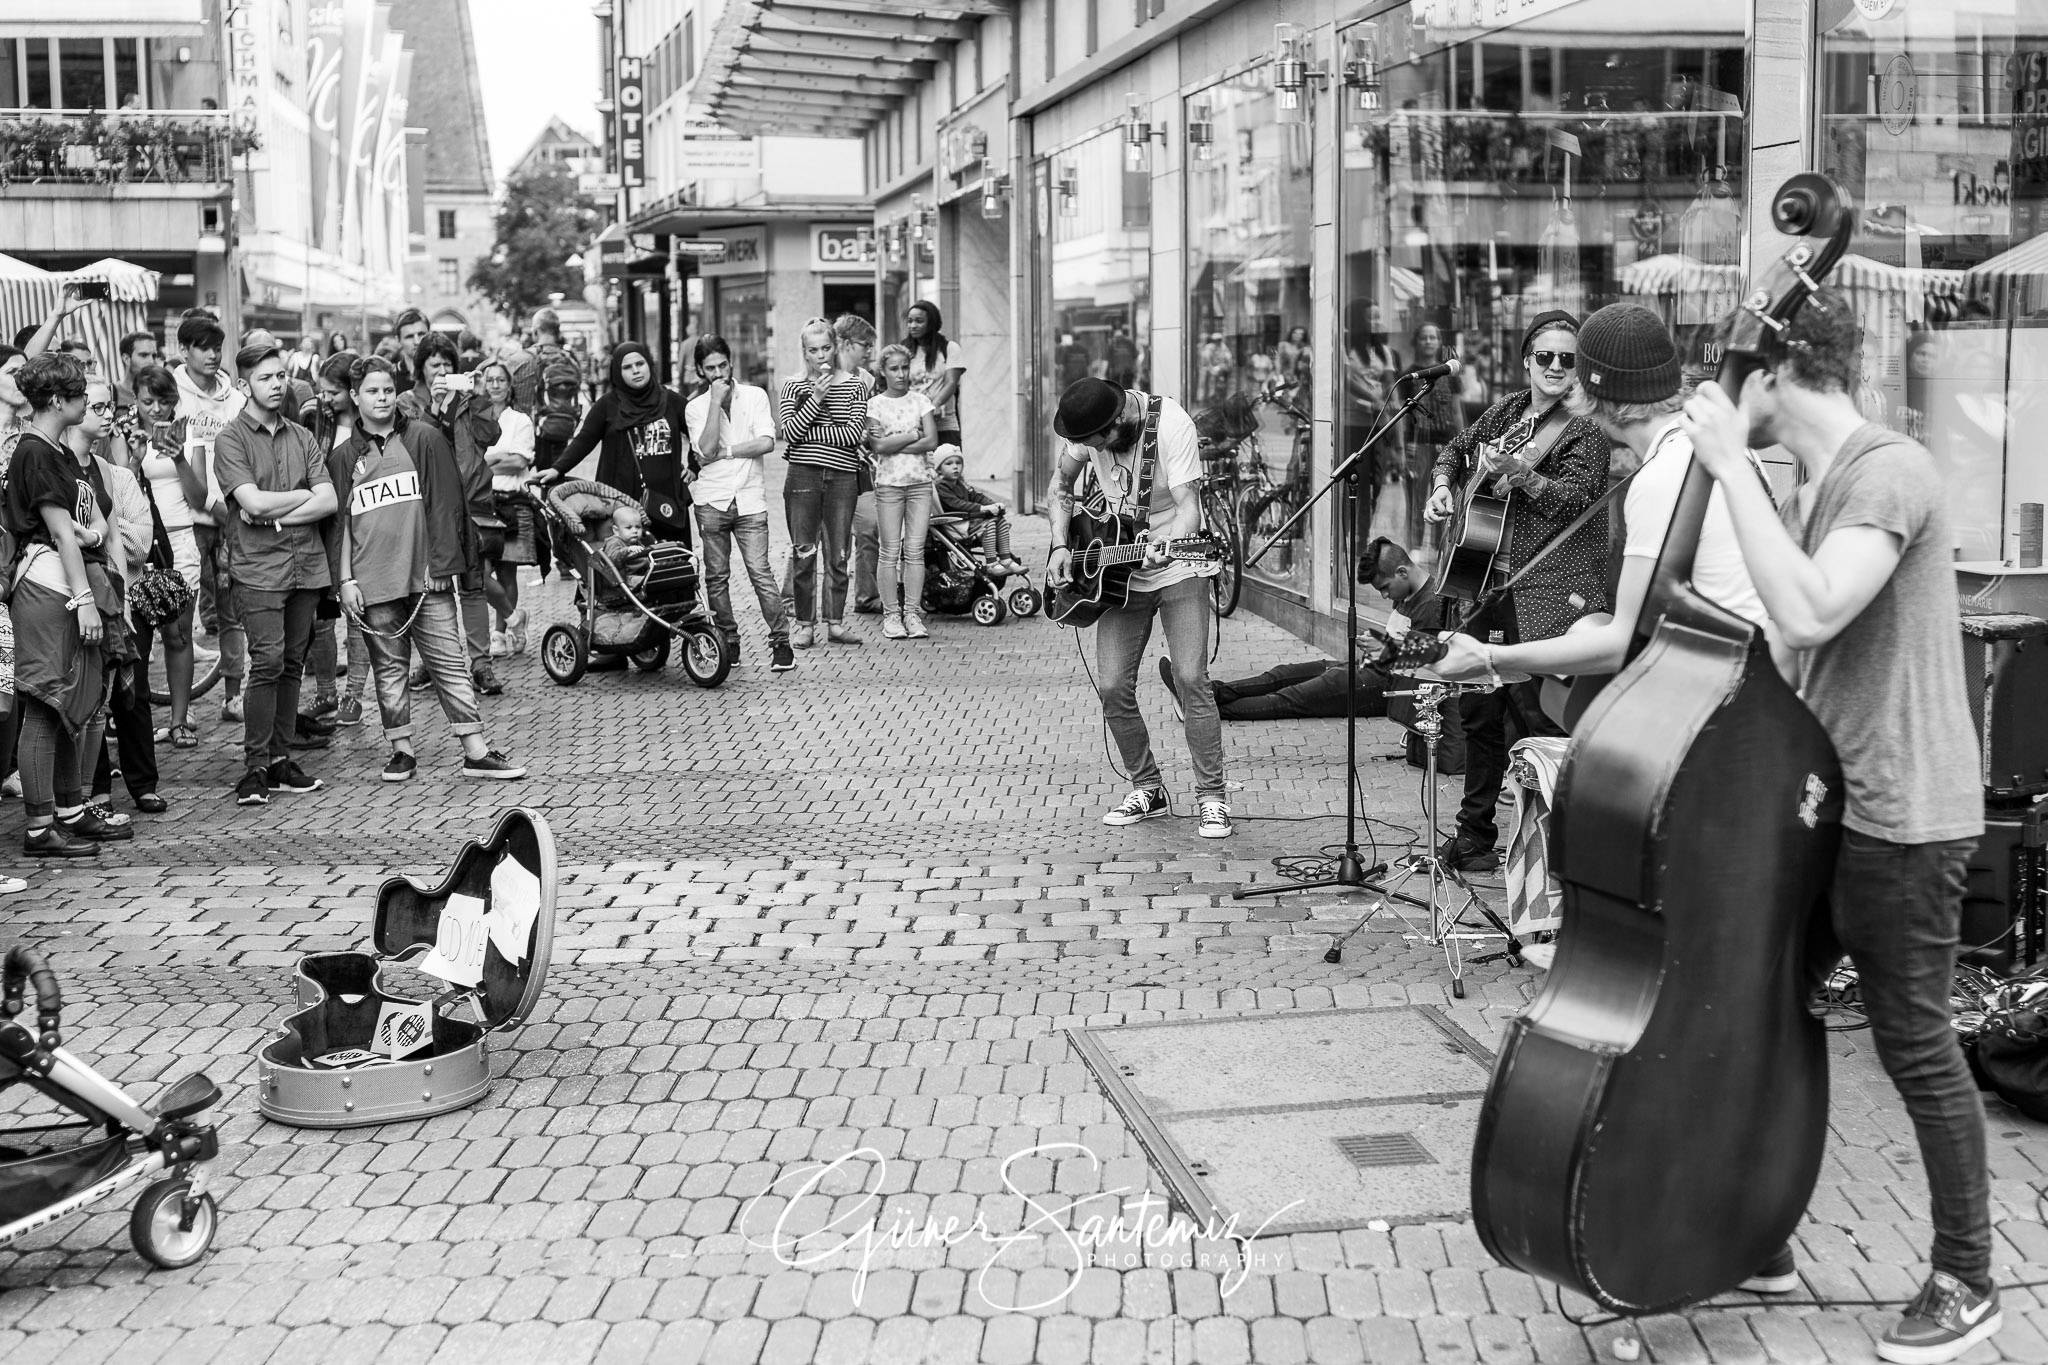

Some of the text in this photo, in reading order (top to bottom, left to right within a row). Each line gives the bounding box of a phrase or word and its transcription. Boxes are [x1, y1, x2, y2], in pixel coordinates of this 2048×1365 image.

[2004, 52, 2048, 91] SYS
[620, 57, 642, 186] HOTEL
[1703, 342, 1723, 364] BO
[358, 475, 421, 508] ITALI
[440, 916, 462, 962] CD
